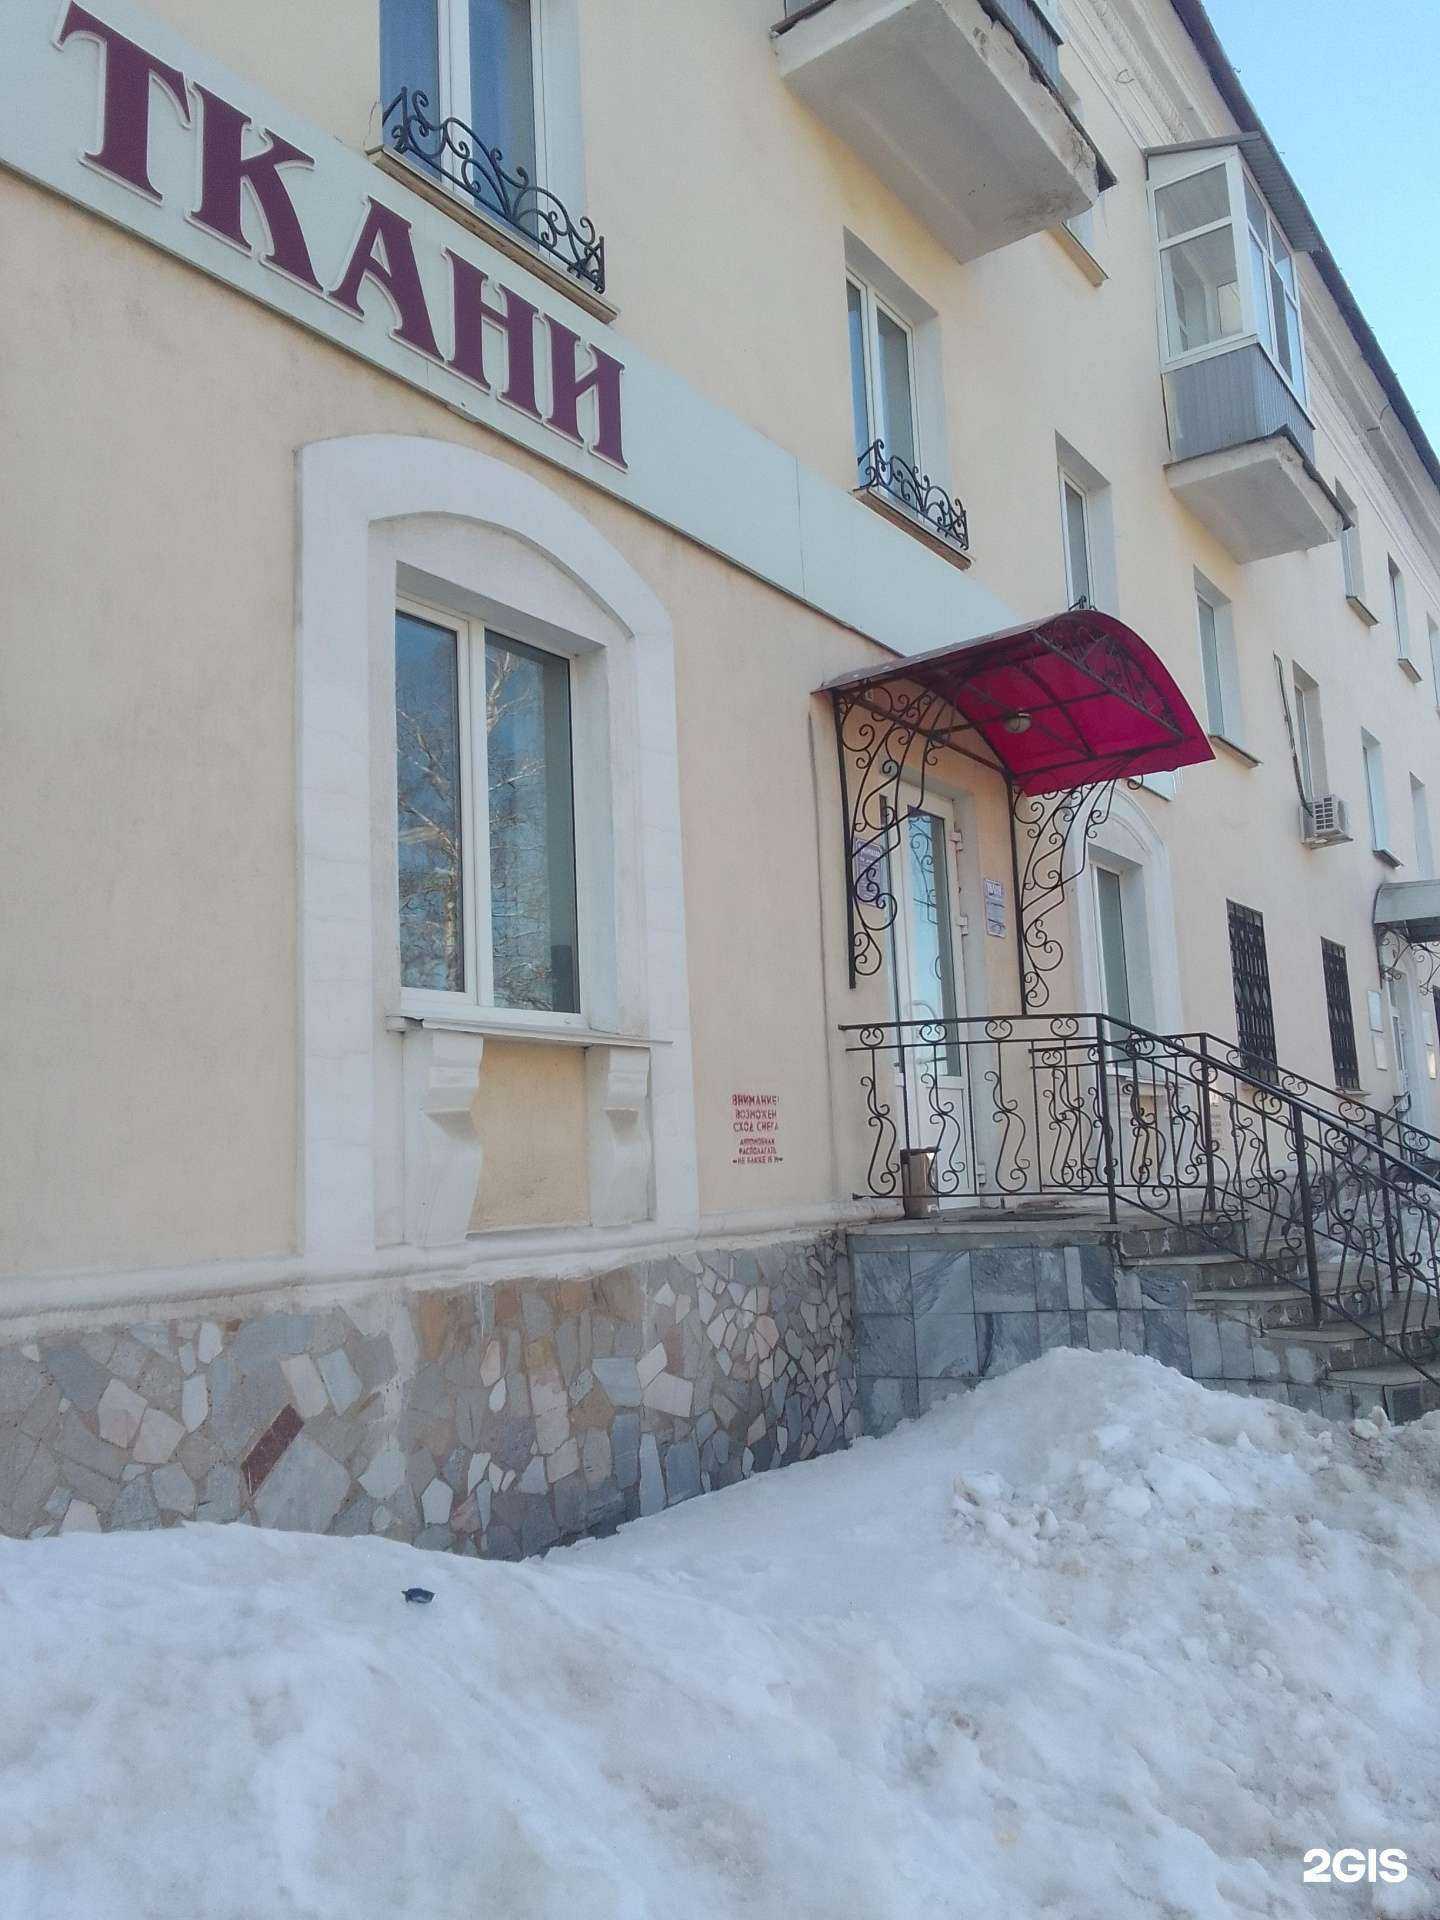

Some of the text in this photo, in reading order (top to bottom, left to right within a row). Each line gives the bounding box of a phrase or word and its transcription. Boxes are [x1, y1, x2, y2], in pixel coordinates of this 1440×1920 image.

[54, 1, 628, 472] ТКАНИ
[733, 1121, 779, 1132] СХОД СНЕГА
